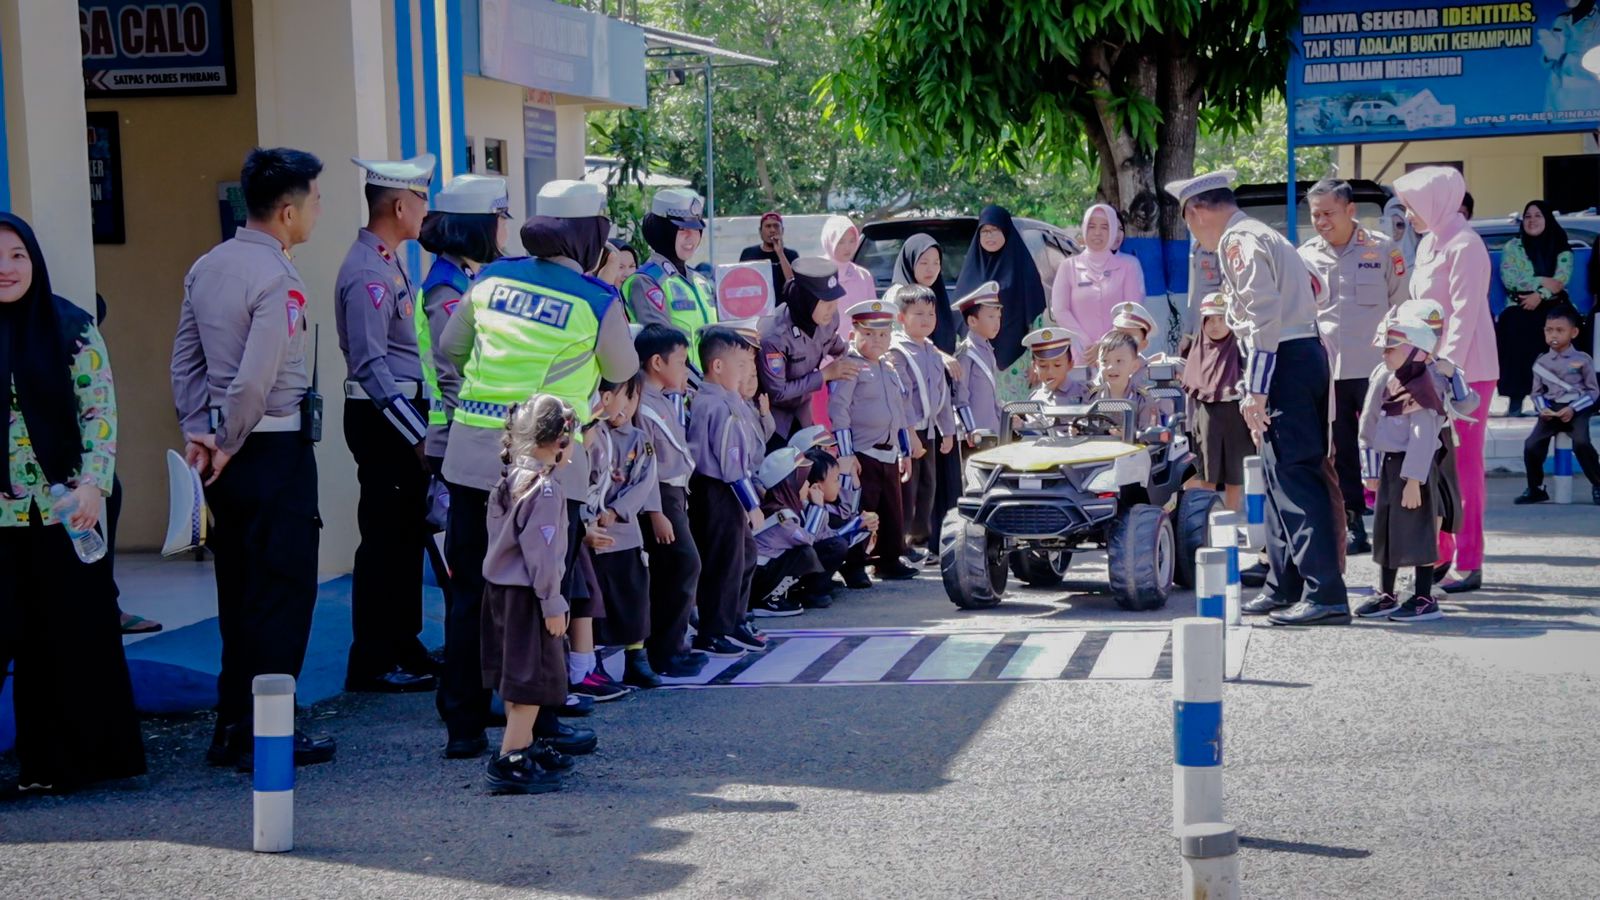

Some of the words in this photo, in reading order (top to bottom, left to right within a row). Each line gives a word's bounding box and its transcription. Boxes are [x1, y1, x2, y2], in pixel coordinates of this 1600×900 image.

[119, 4, 208, 58] CALO
[1303, 13, 1359, 35] HANYA
[1361, 9, 1439, 31] SEKEDAR
[1442, 2, 1536, 27] IDENTITAS,
[1303, 40, 1330, 59] TAPI
[1333, 38, 1356, 57] SIM
[1358, 35, 1408, 55] ADALAH
[1410, 33, 1449, 53] BUKTI
[1451, 28, 1531, 50] KEMAMPUAN
[113, 74, 144, 86] SATPAS
[146, 73, 178, 84] POLRES
[181, 71, 221, 83] PINRANG
[1304, 63, 1339, 83] ANDA
[1340, 60, 1384, 81] DALAM
[1385, 56, 1462, 79] MENGEMUDI
[1463, 115, 1506, 125] SATPAS
[1509, 112, 1553, 122] POLRES
[494, 286, 570, 326] POLISI
